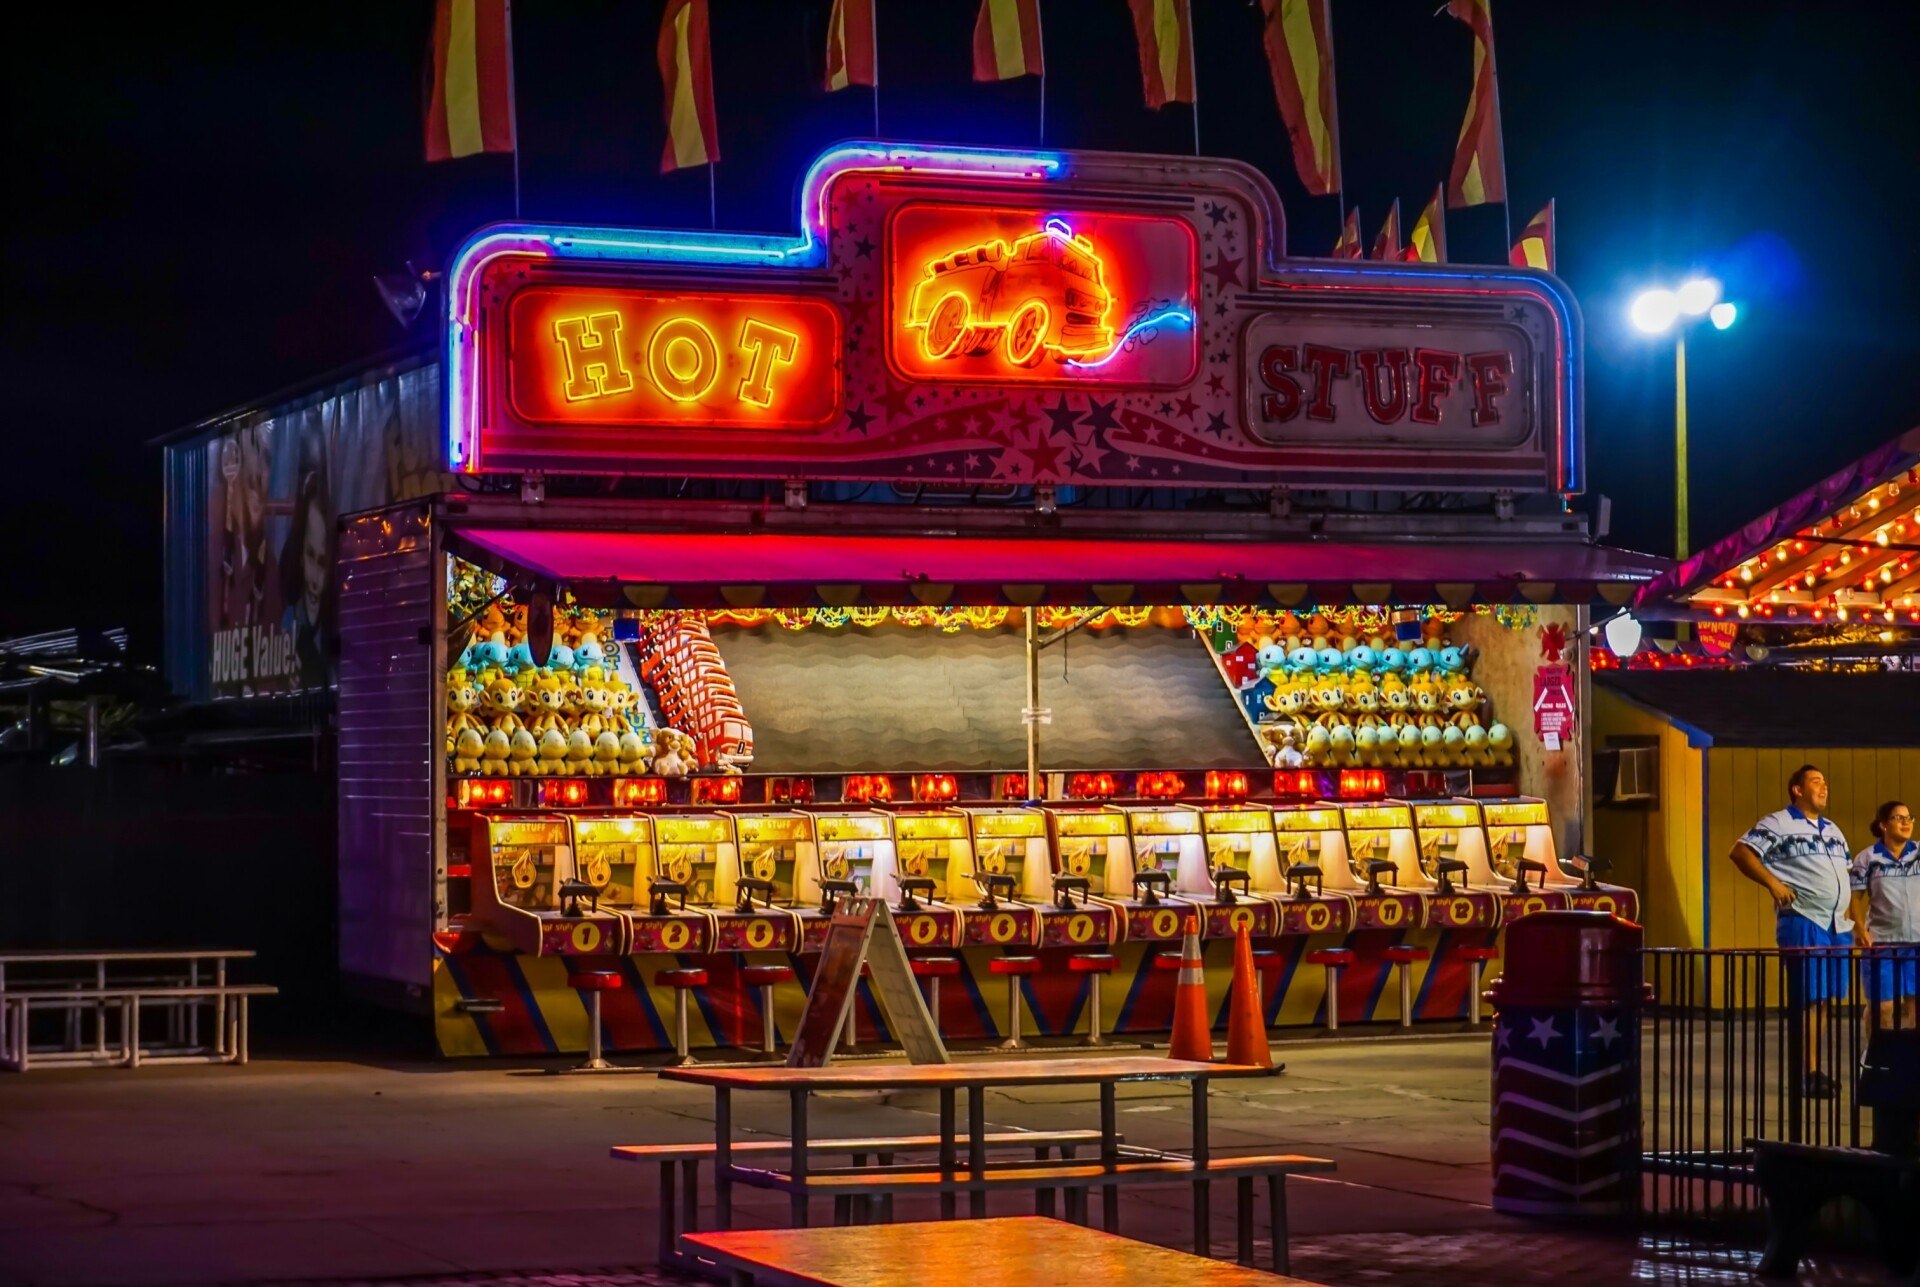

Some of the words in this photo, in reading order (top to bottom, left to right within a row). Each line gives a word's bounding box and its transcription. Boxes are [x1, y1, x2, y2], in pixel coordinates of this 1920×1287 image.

[552, 310, 799, 409] HOT
[1259, 343, 1514, 428] STUFF
[1697, 621, 1737, 637] WINNER
[212, 627, 249, 683] HUGE
[252, 620, 297, 678] Value!
[1310, 908, 1327, 926] 10
[1383, 903, 1398, 920] 11
[1454, 901, 1470, 919] 12
[997, 918, 1009, 937] 6
[1158, 914, 1172, 933] 8
[581, 926, 591, 945] 1
[668, 924, 683, 943] 2
